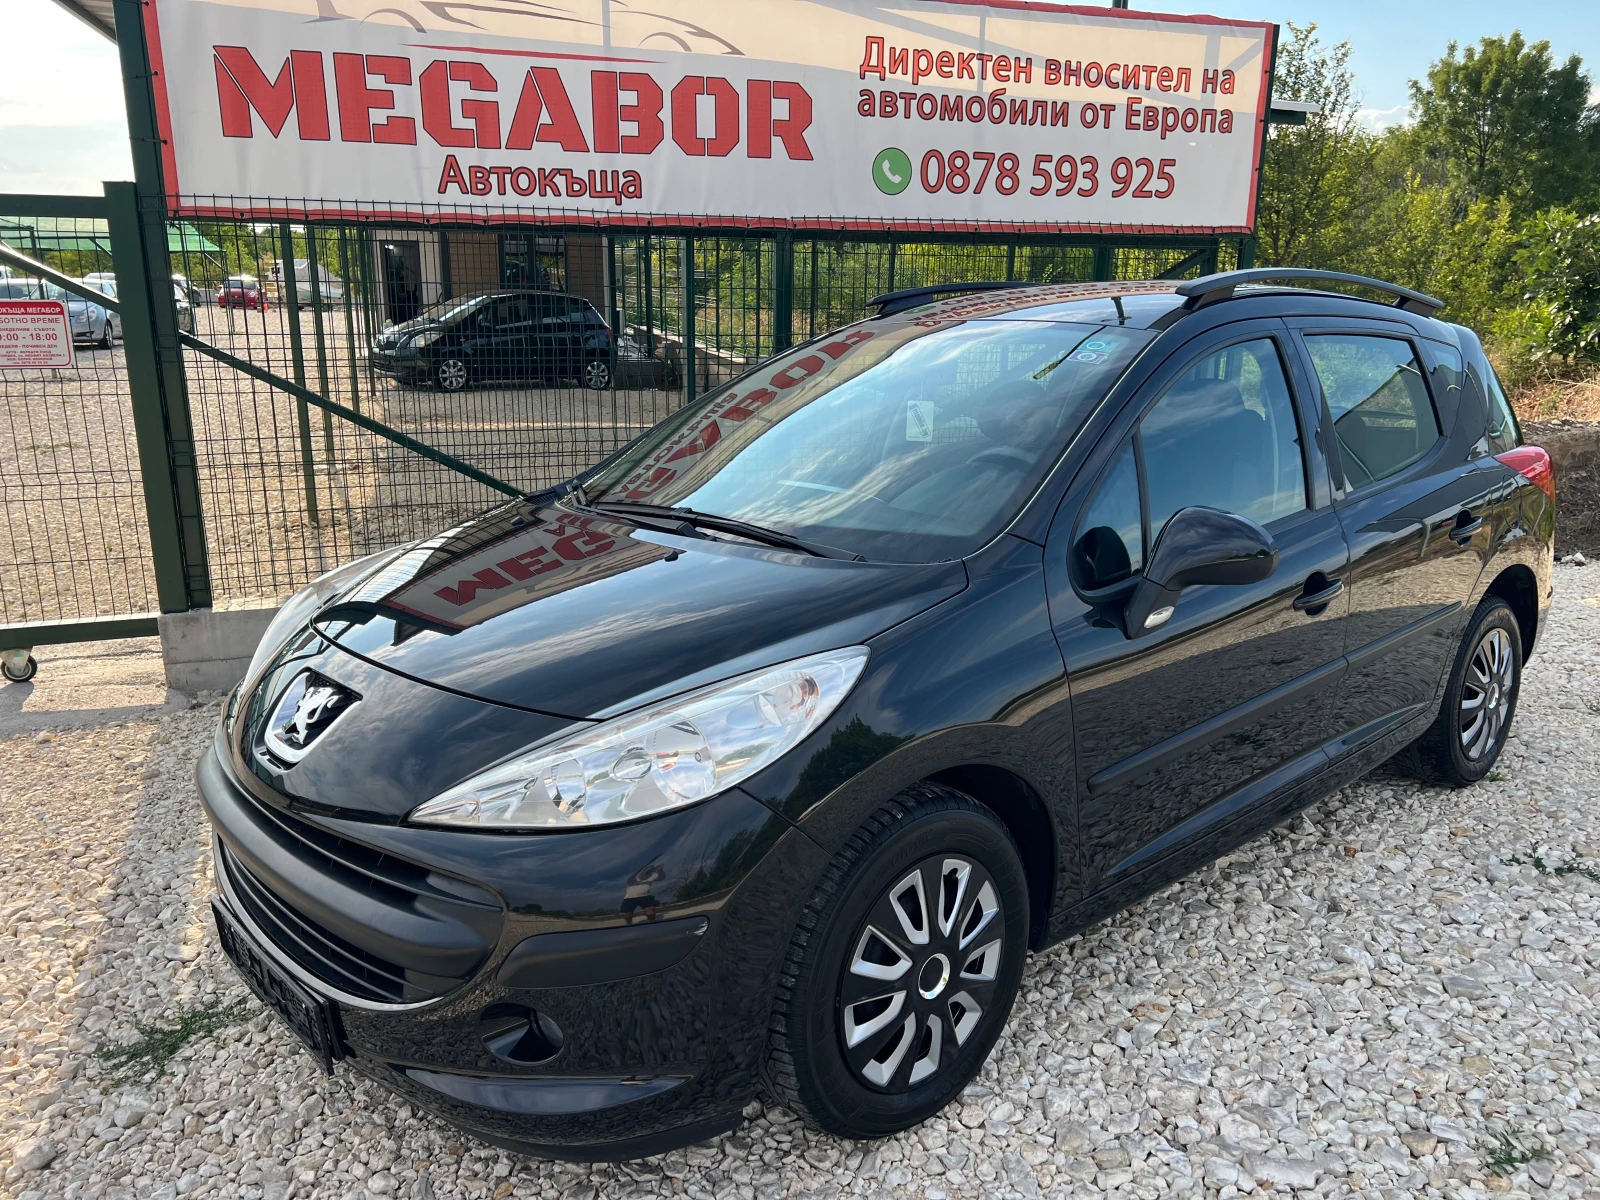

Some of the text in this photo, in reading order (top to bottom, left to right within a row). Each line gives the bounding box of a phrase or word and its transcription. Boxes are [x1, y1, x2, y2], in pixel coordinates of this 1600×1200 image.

[859, 36, 1236, 95] Директен вносител на
[214, 45, 814, 160] MEGABOR
[857, 88, 1234, 139] автомобили от Европа
[438, 154, 642, 204] Автокъща
[919, 149, 1177, 199] 0878 593 925
[29, 332, 58, 341] 18:00
